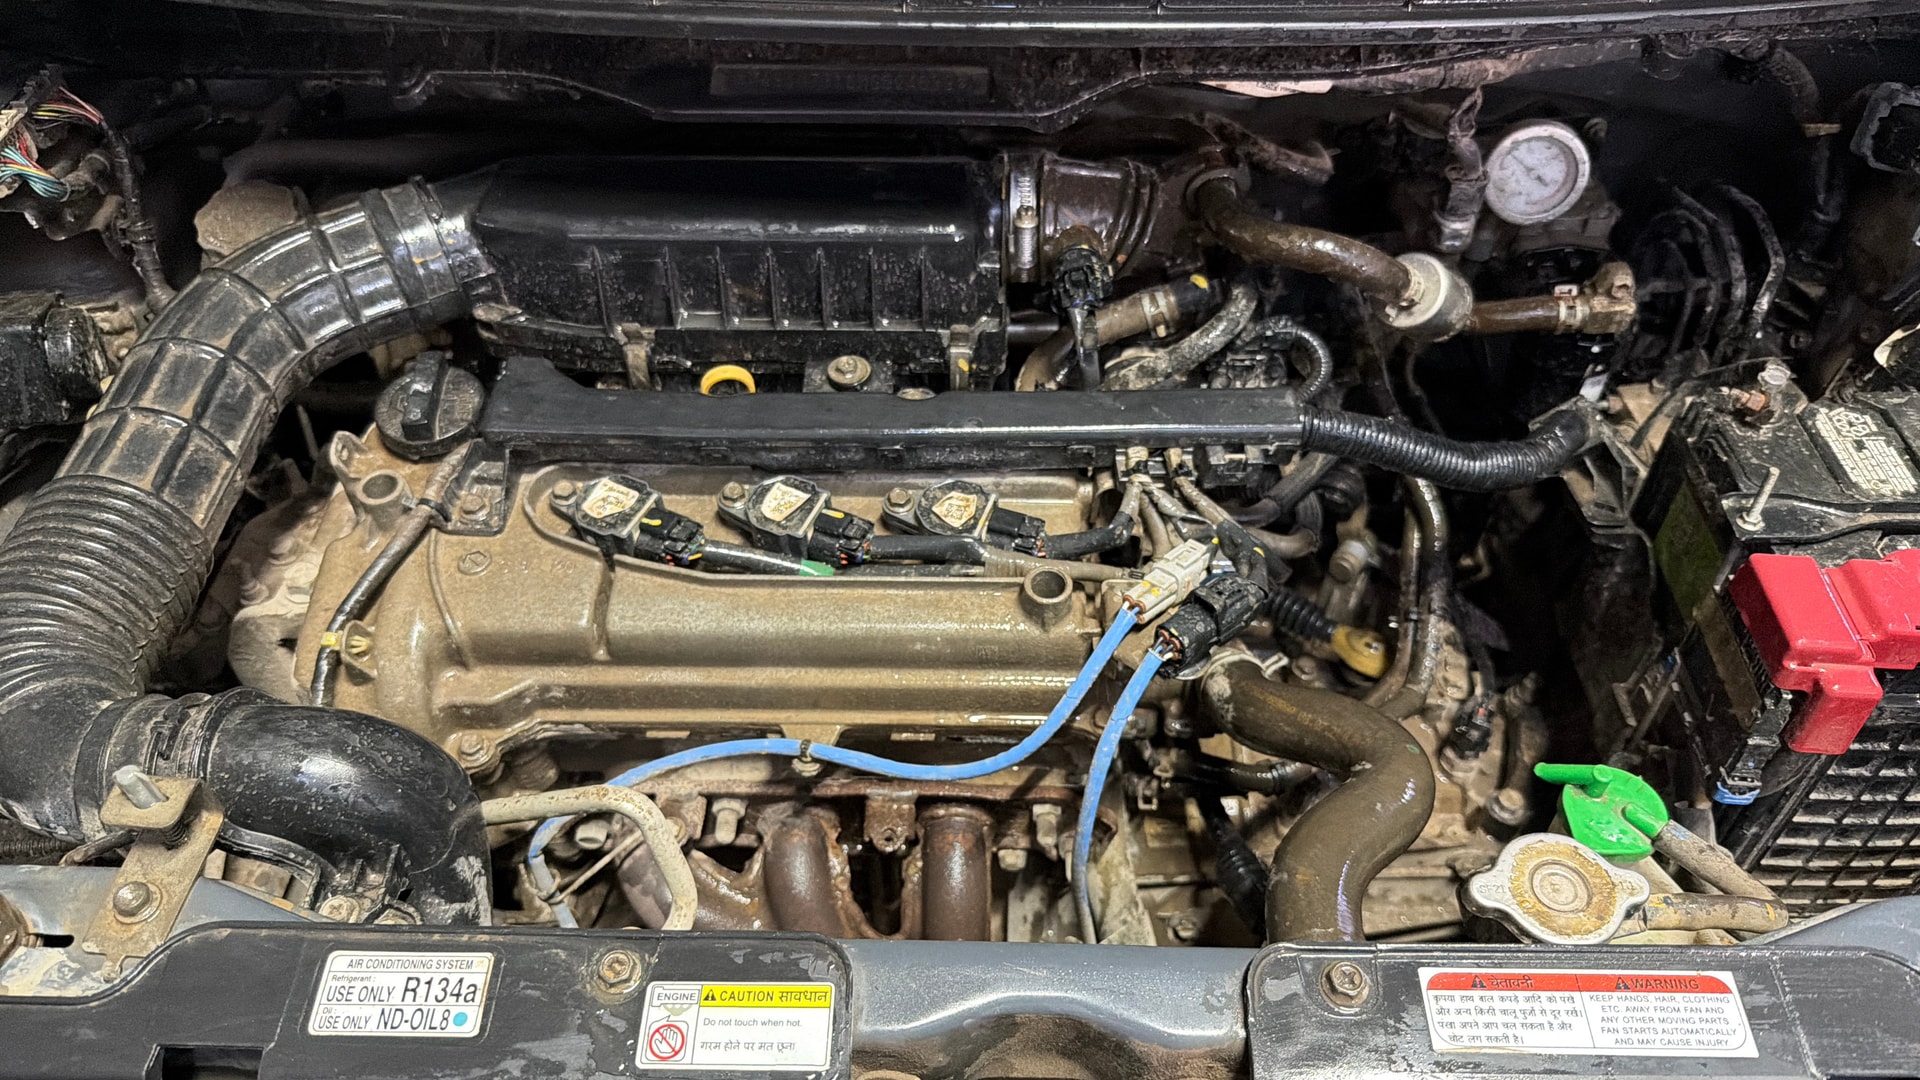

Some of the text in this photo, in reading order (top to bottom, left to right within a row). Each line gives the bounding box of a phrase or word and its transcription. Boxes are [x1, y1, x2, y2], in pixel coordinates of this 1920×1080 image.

[347, 958, 474, 970] AIR CONDITIONING SYSTEM
[1488, 975, 1533, 988] चेतावनी
[1631, 978, 1700, 991] WARNING
[326, 976, 478, 1004] USE ONLY R134a
[656, 992, 698, 1002] ENGINE
[719, 990, 829, 1003] CAUTION सावधान
[1432, 994, 1456, 1006] कृपया
[1523, 993, 1542, 1004] आदि
[1545, 993, 1557, 1004] को
[1589, 994, 1730, 1005] KEEP HANDS, HAIR, CLOTHING
[1435, 1005, 1451, 1017] और
[1454, 1008, 1472, 1017] अन्य
[1474, 1005, 1496, 1017] किसी
[1539, 1006, 1548, 1017] से
[1601, 1005, 1725, 1015] ETC. AWAY FROM FAN AND
[318, 1007, 451, 1031] USE ONLY ND-OIL8
[703, 1018, 803, 1028] Do not touch when hot.
[1459, 1018, 1479, 1030] अपने
[1482, 1021, 1499, 1030] आप
[1519, 1022, 1545, 1032] सकता
[1547, 1020, 1555, 1032] है
[1557, 1020, 1573, 1032] और
[1601, 1016, 1730, 1026] ANY OTHER MOVING PARTS
[1600, 1026, 1737, 1037] FAN STARTS AUTOMATICALLY
[1467, 1035, 1483, 1043] लग
[1484, 1033, 1510, 1044] सकती
[1614, 1038, 1729, 1048] AND MAY CAUSE INJURY
[700, 1041, 722, 1051] गरम
[724, 1039, 741, 1052] होने
[743, 1041, 756, 1051] पर
[758, 1041, 774, 1052] मत
